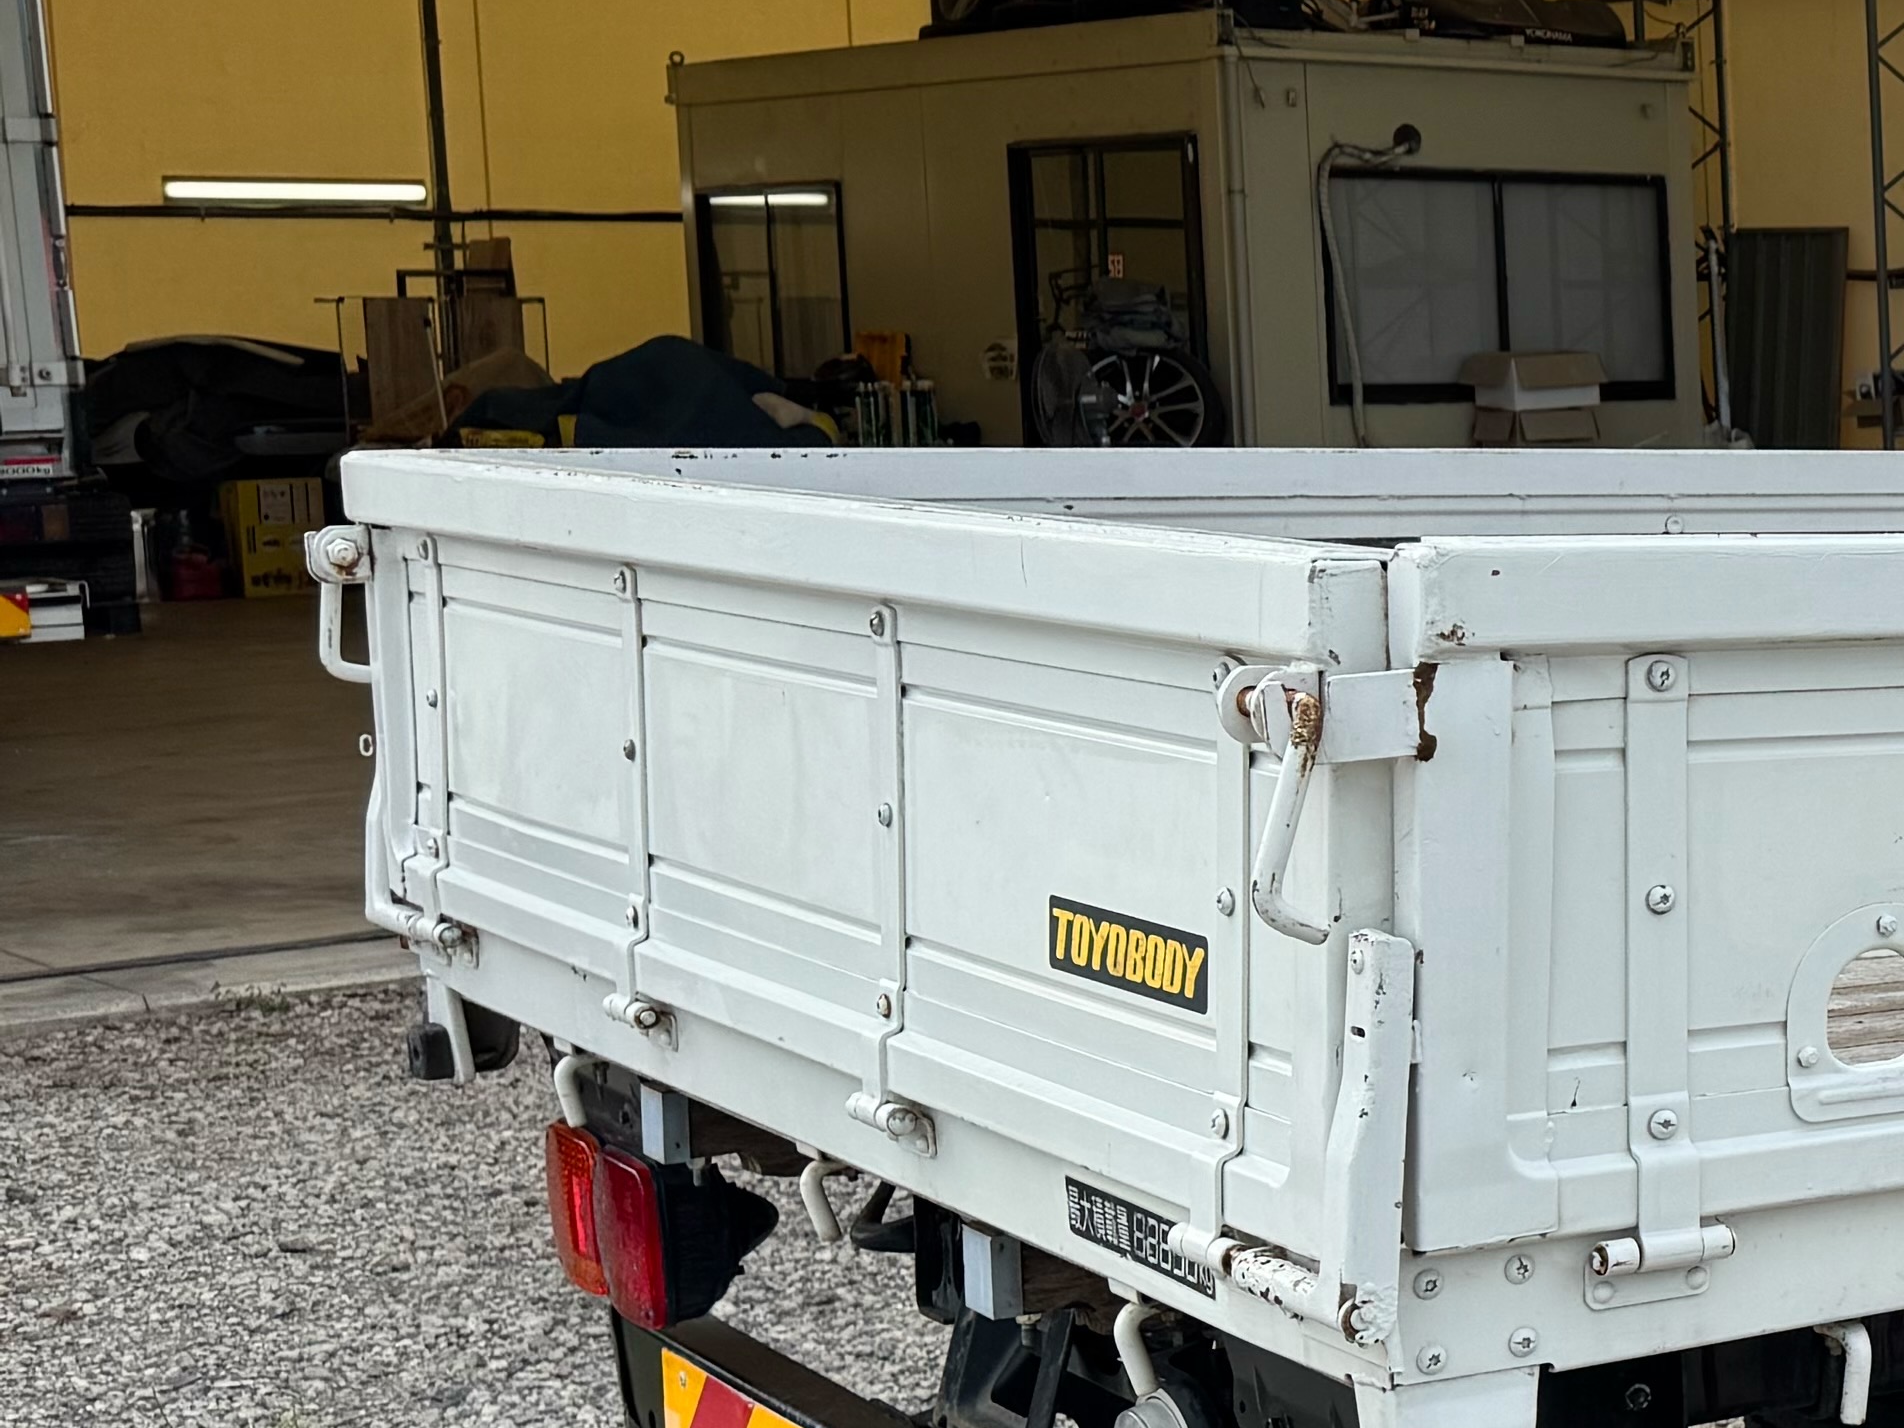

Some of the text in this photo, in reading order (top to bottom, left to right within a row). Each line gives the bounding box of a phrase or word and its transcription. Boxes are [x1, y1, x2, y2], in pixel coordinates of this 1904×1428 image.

[1052, 907, 1205, 999] TOYOBODY
[1068, 1185, 1131, 1251] 最大積載量
